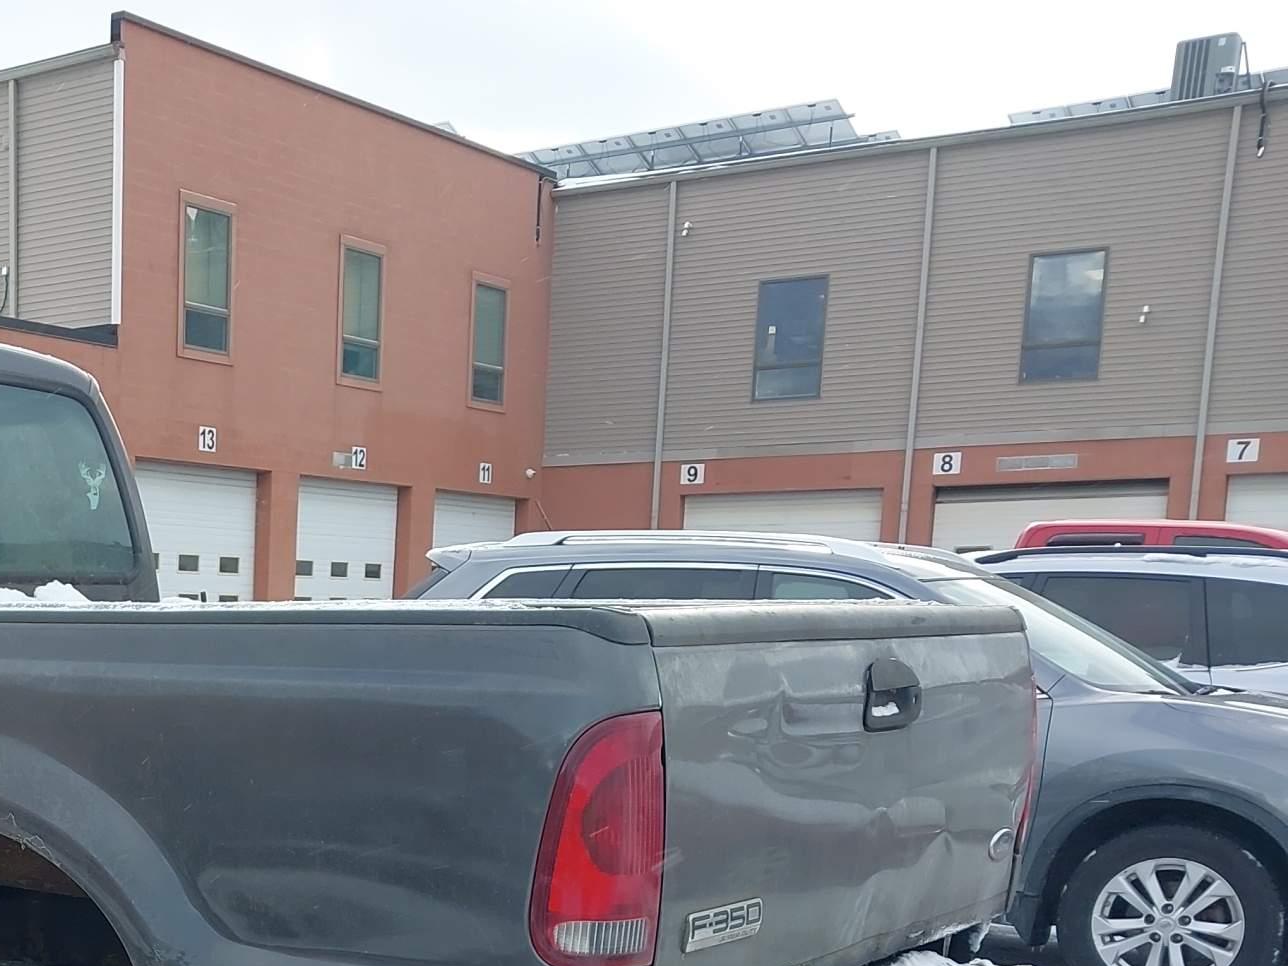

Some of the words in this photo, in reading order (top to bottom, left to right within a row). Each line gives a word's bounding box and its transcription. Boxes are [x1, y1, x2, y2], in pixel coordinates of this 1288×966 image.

[200, 429, 215, 450] 13
[353, 448, 365, 468] 12
[1238, 441, 1251, 460] 7
[941, 454, 953, 473] 8
[481, 465, 490, 482] 11
[687, 465, 698, 483] 9
